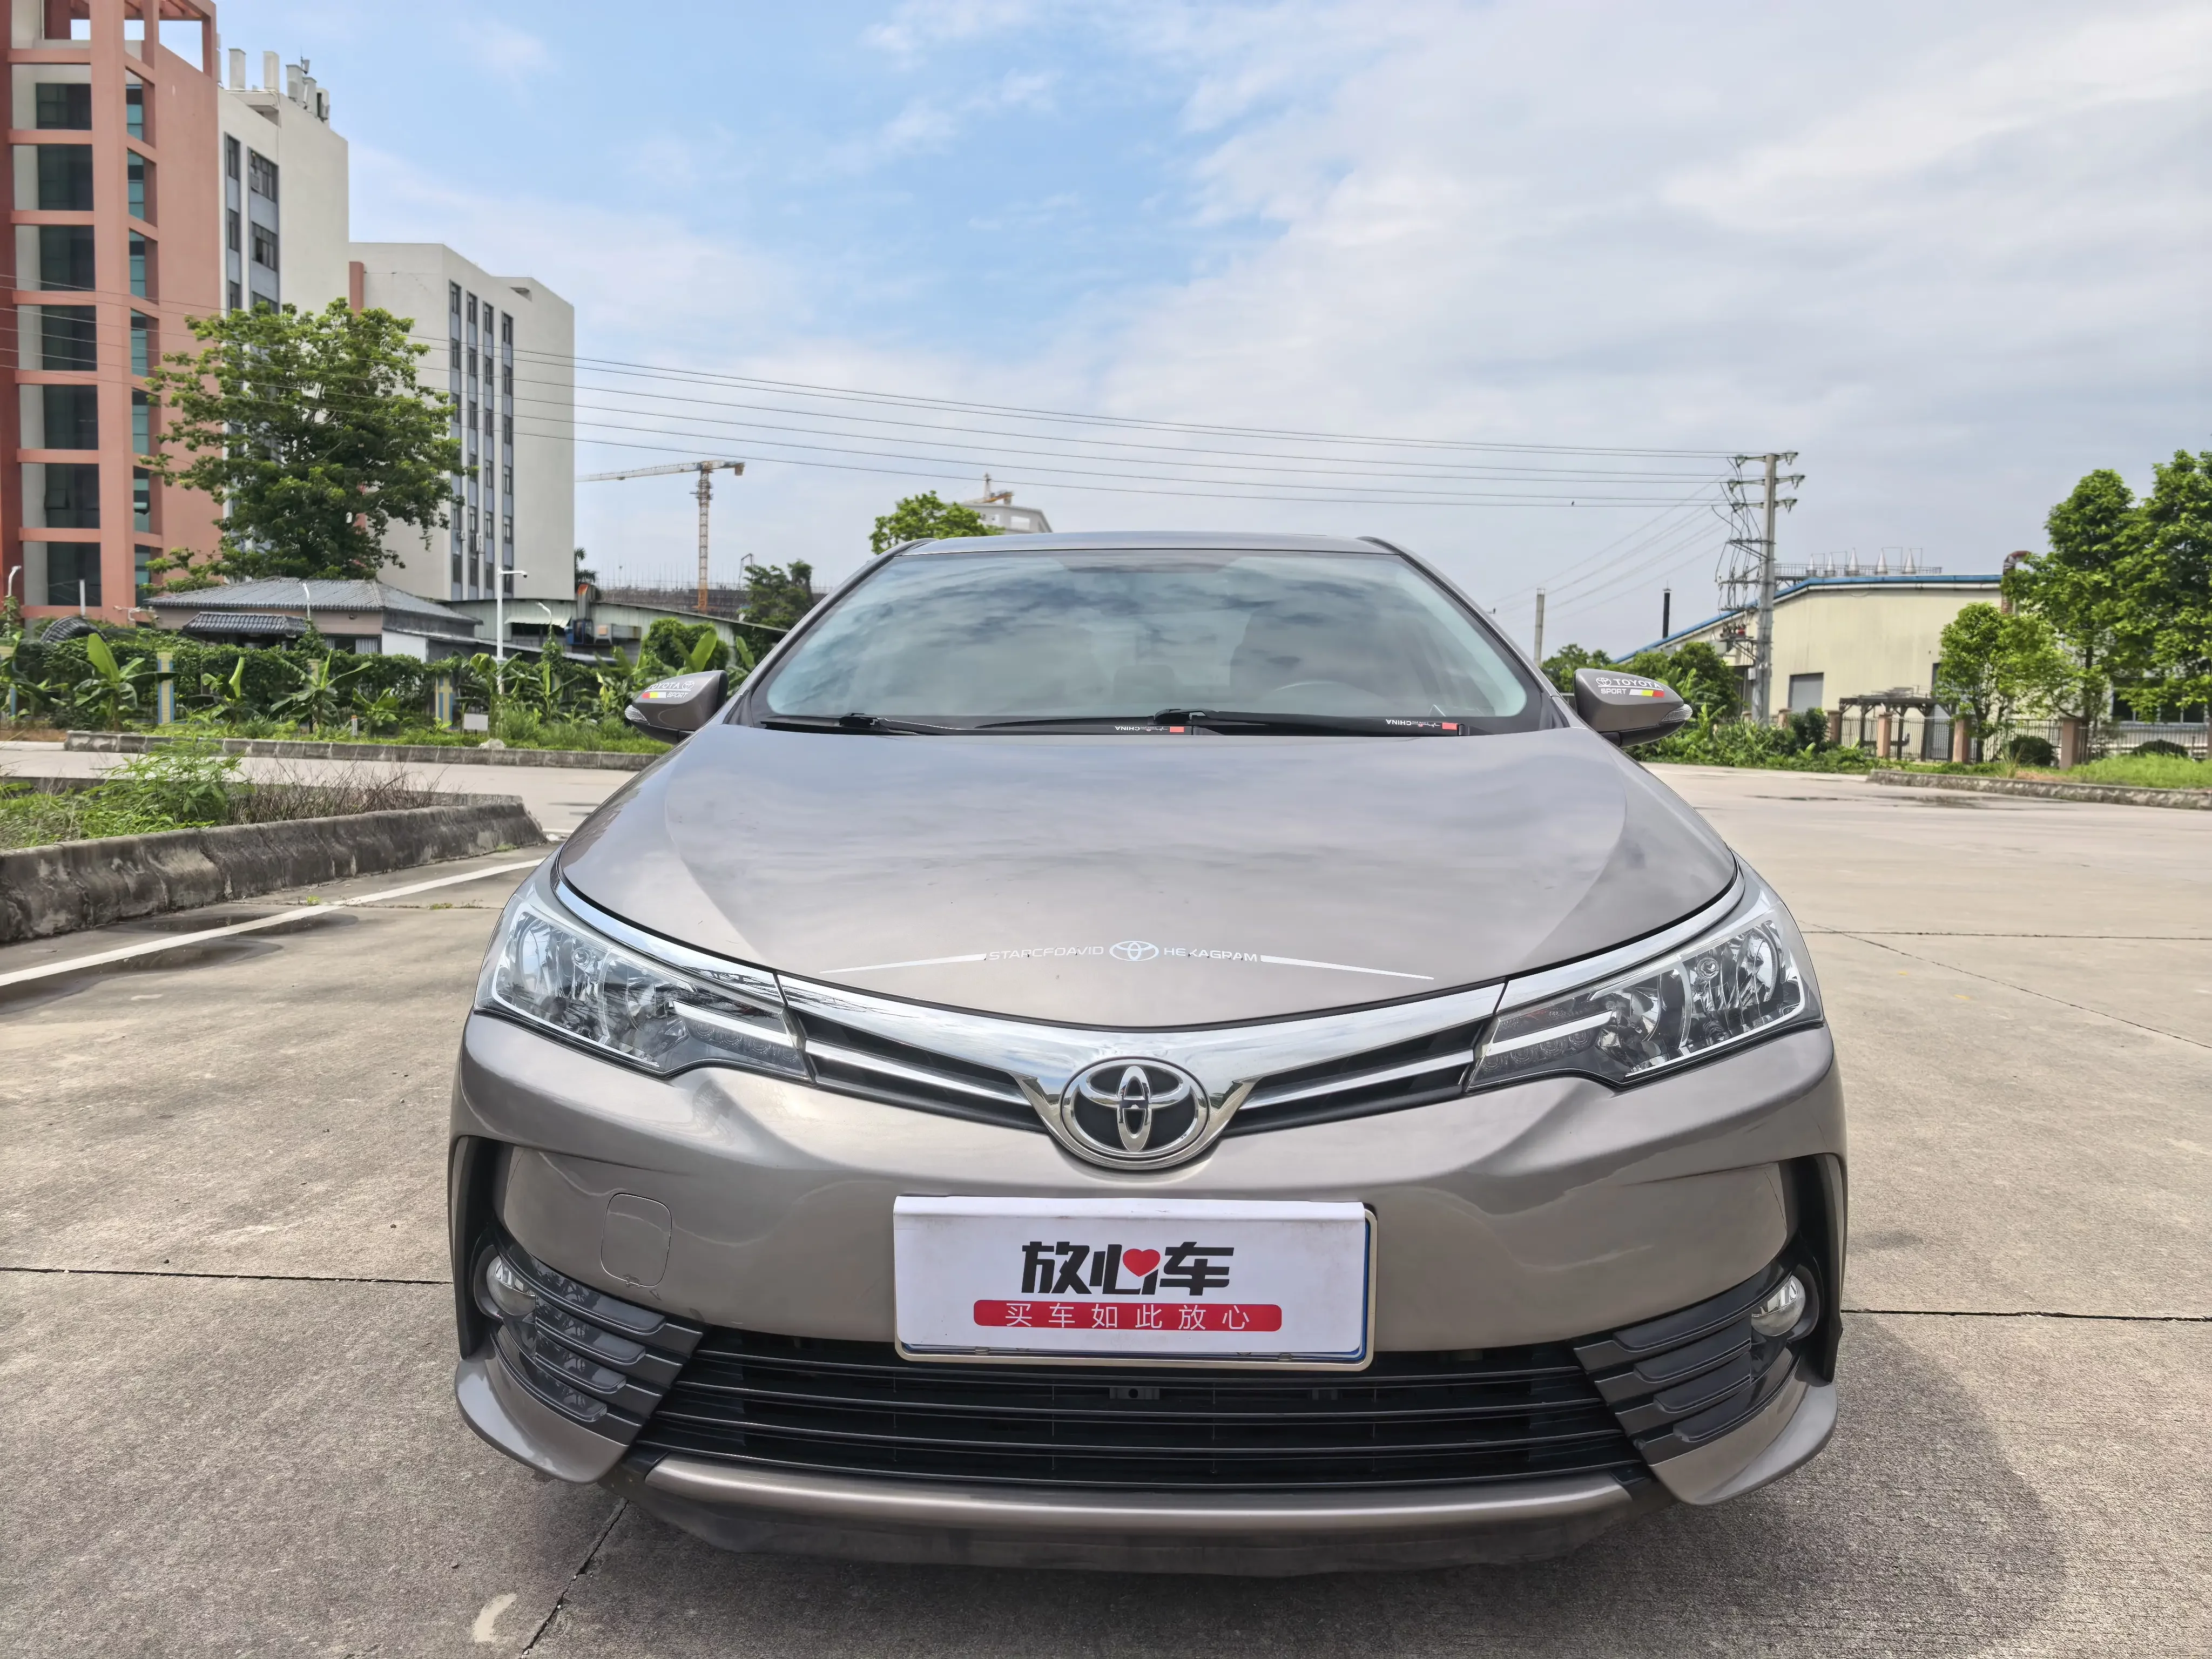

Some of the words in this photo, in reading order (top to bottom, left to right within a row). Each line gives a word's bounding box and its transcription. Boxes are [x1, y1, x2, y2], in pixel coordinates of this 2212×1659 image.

[648, 682, 680, 690] TOYOTA
[1613, 679, 1662, 689] TOYOTA
[1021, 1240, 1234, 1296] 放心车
[1004, 1302, 1250, 1331] 买车如此放心
